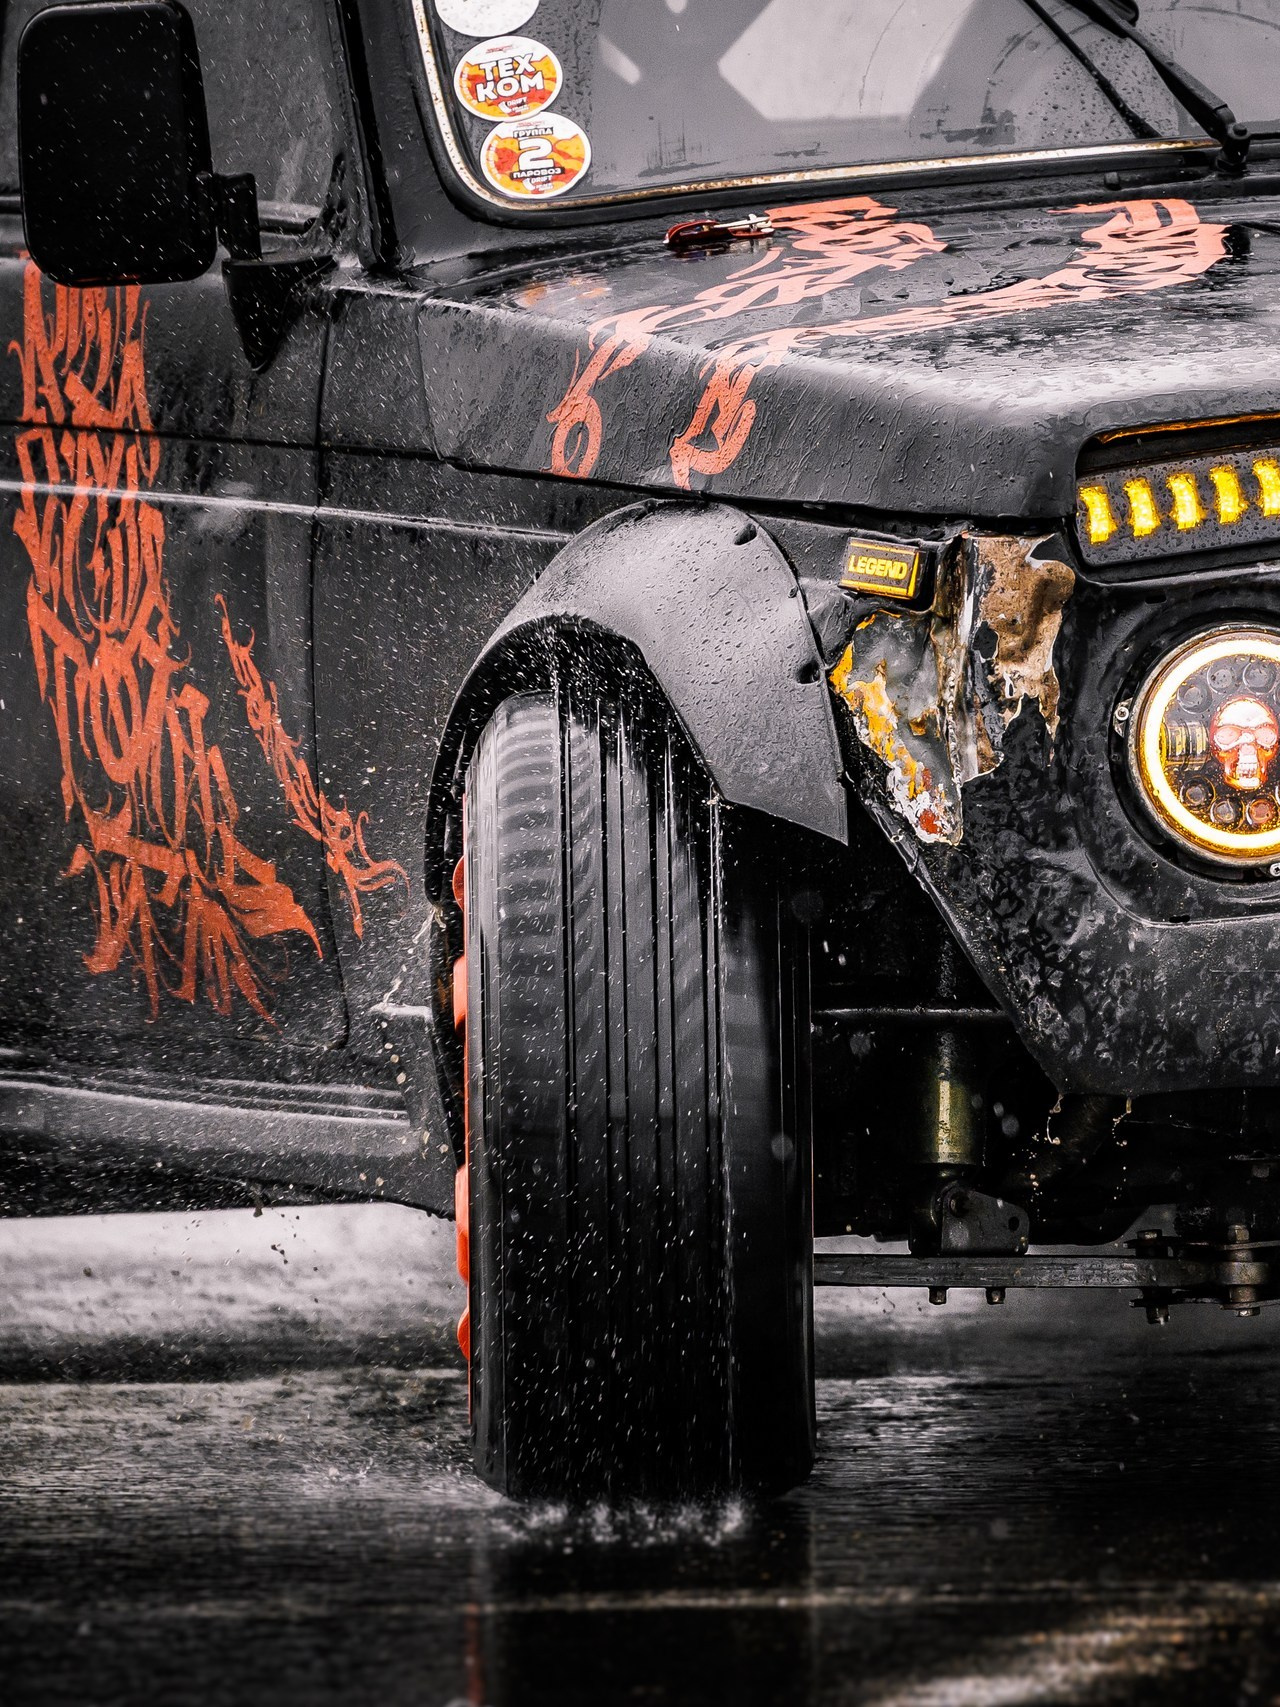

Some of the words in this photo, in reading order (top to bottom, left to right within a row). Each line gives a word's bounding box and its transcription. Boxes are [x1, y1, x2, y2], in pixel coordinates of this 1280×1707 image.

[513, 127, 553, 138] ГРУППА
[518, 137, 555, 170] 2
[512, 167, 562, 178] ПАРОВОЗ
[847, 554, 909, 580] LEGEND
